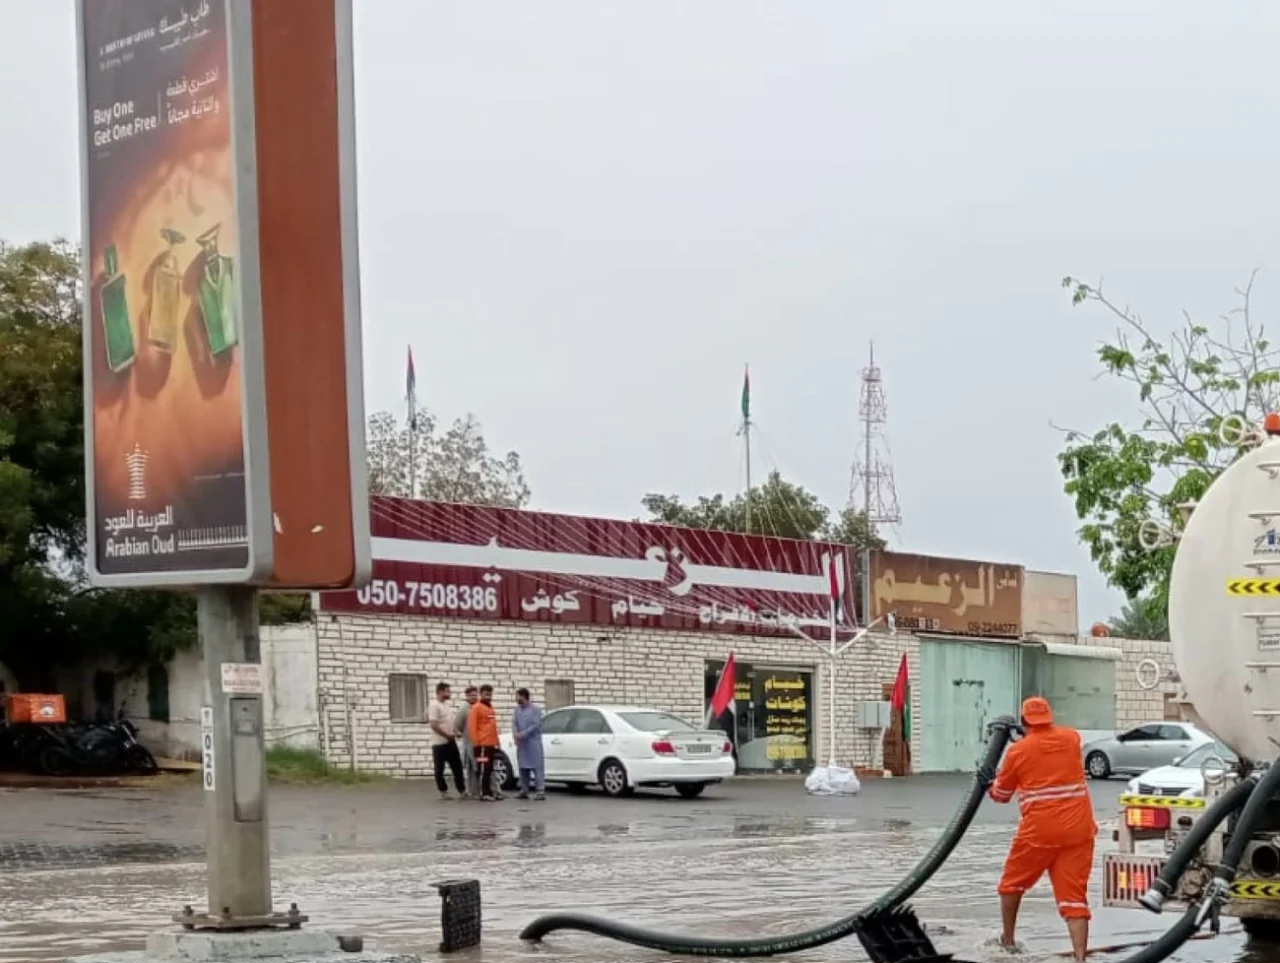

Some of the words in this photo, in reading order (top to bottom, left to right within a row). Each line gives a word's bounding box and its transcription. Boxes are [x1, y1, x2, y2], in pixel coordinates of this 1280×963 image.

[93, 108, 112, 126] Buy
[113, 101, 134, 119] One
[94, 129, 111, 146] Get
[112, 123, 132, 141] One
[134, 116, 157, 134] Free
[104, 508, 134, 536] للعود
[137, 505, 174, 532] العربية
[105, 536, 150, 558] Arabian
[151, 532, 175, 554] Oud
[357, 580, 497, 612] 050-7508386
[521, 588, 582, 613] كوش
[874, 564, 995, 617] الزعيم
[611, 596, 666, 619] خيام
